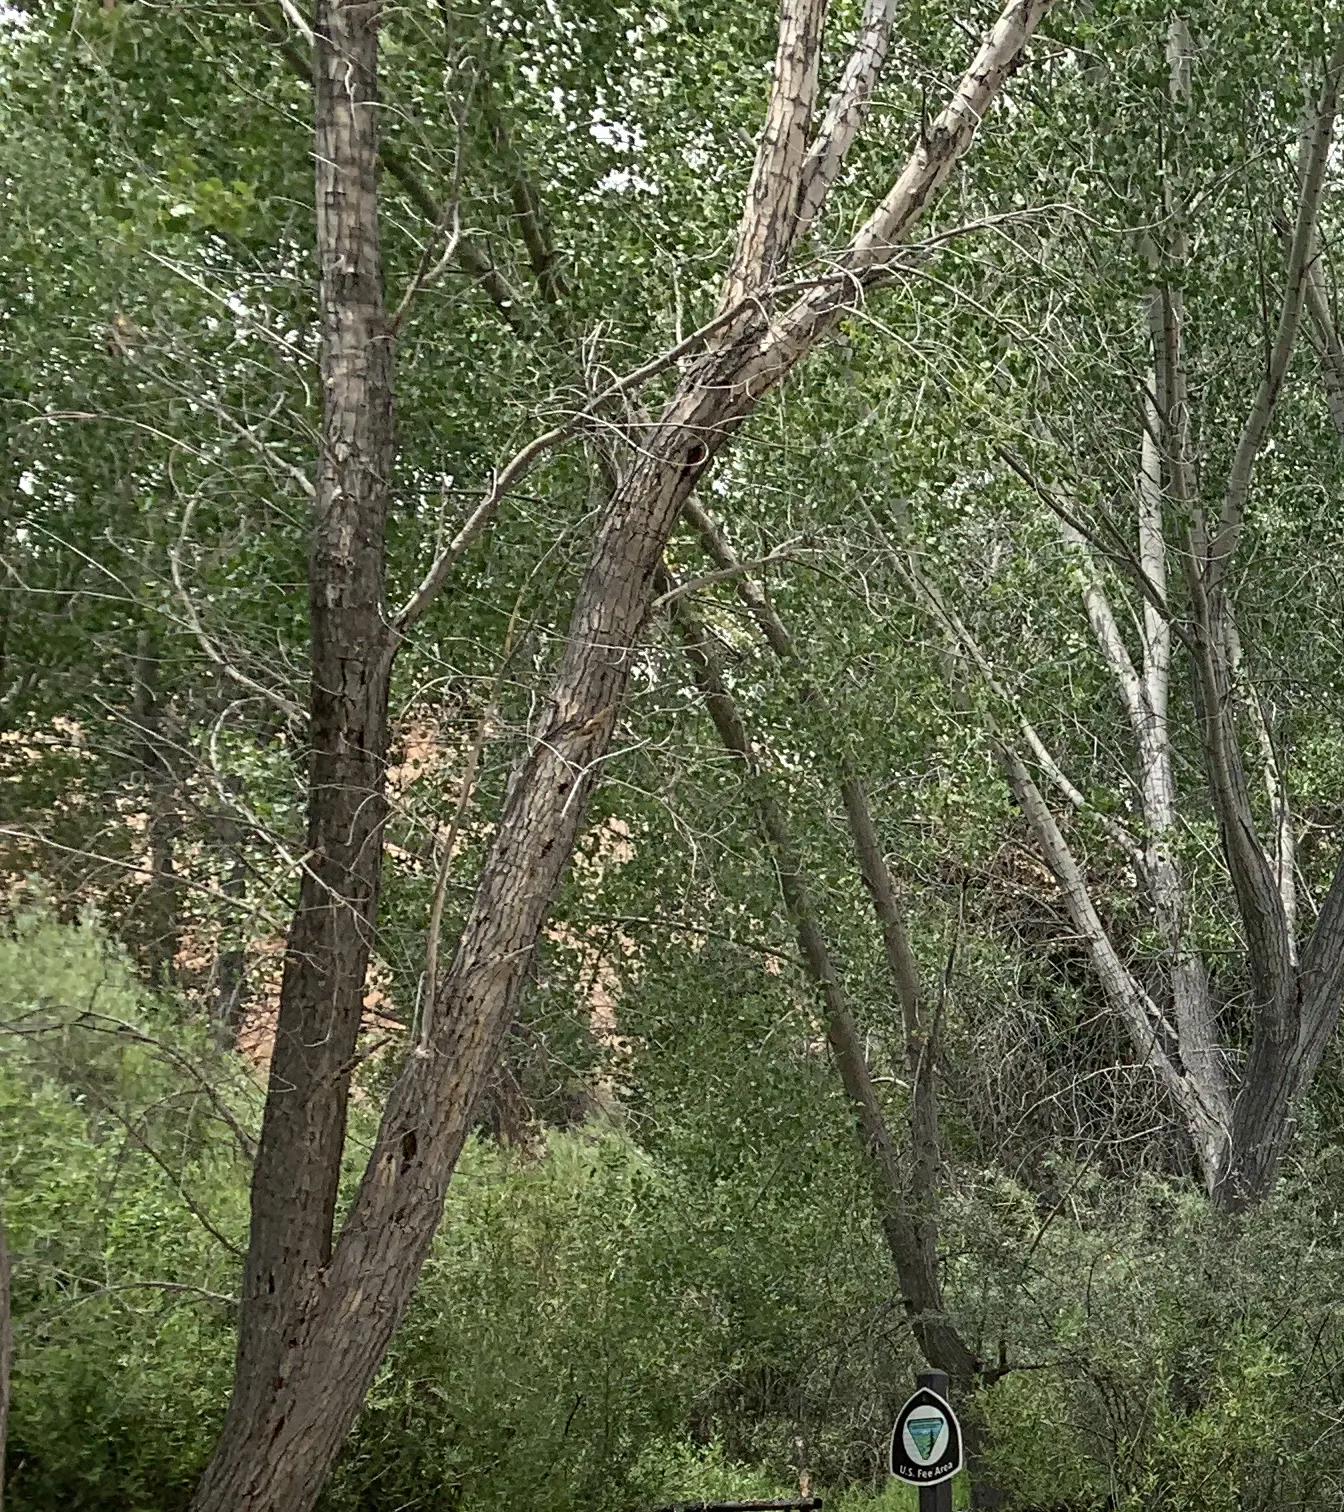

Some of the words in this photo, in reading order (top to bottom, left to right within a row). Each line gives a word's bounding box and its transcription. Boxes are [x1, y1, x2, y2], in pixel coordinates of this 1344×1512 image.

[900, 1465, 915, 1477] U.S.
[917, 1469, 933, 1479] Fee
[934, 1462, 953, 1476] Area
